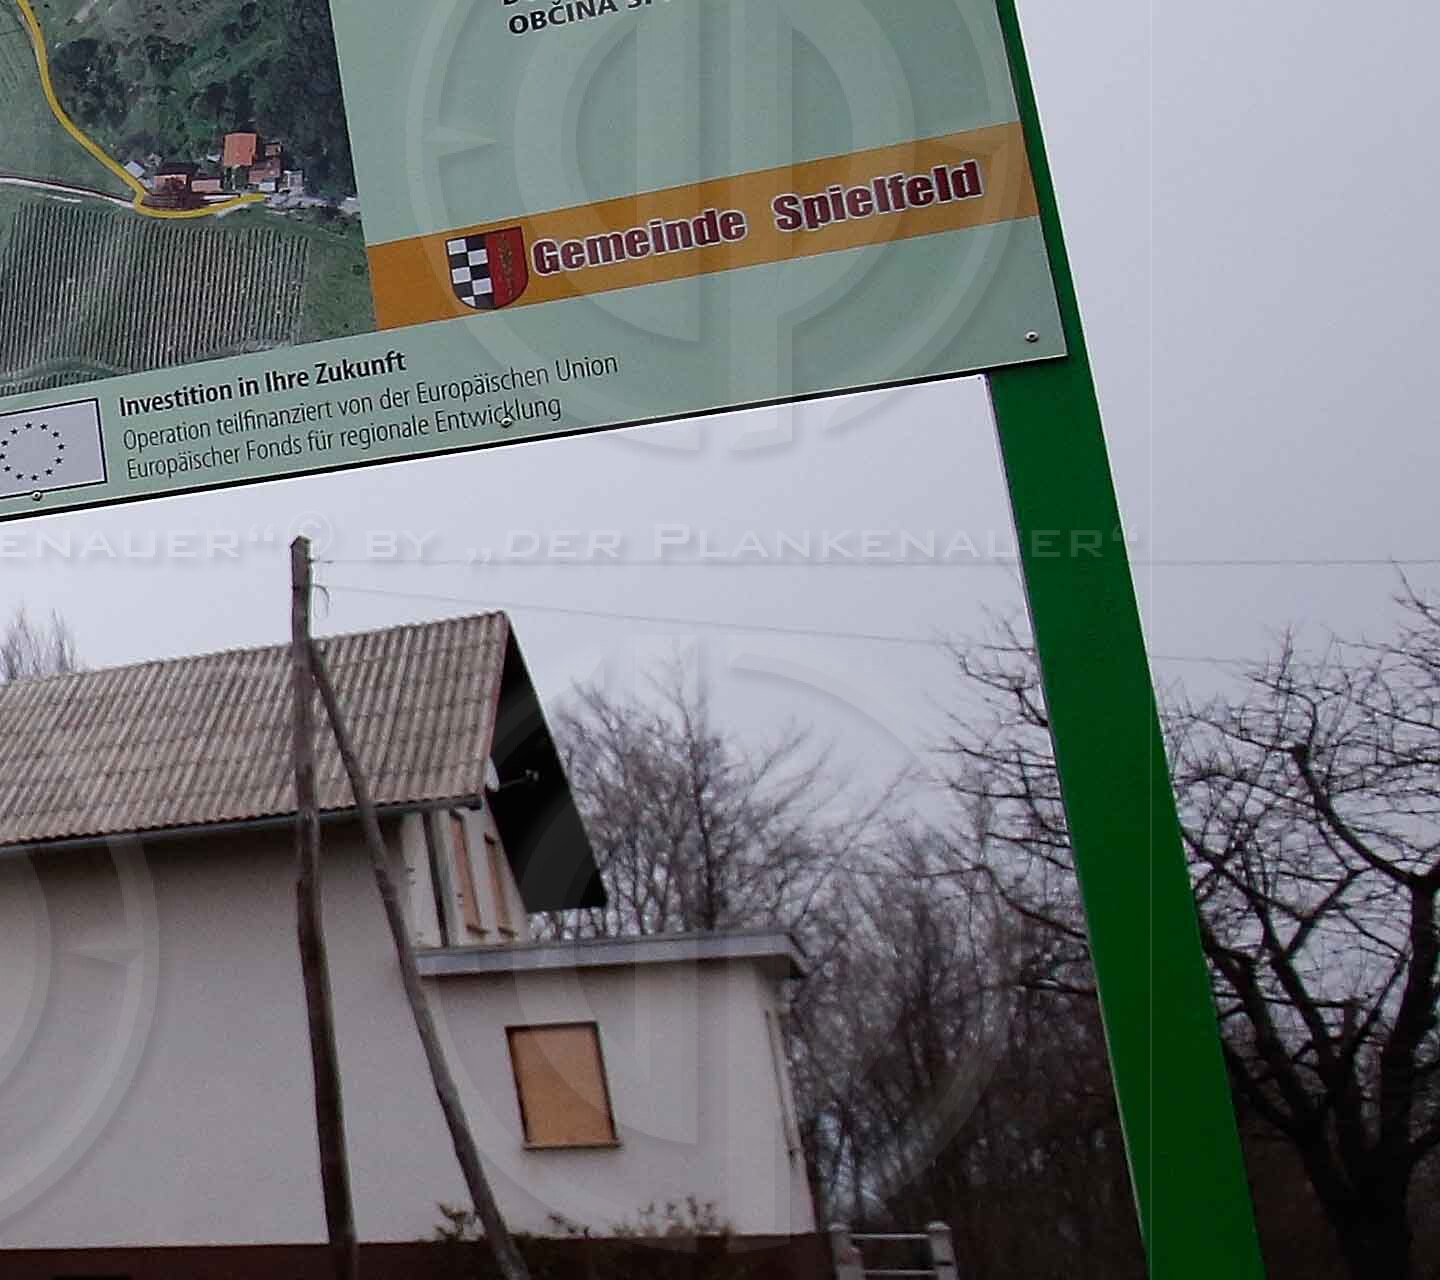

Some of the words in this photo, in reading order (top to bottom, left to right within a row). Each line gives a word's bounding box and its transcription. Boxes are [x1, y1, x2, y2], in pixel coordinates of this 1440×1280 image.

[532, 208, 748, 276] Gemeinde
[771, 160, 983, 232] Spielfeld
[120, 384, 232, 416] Investition
[238, 377, 259, 397] in
[265, 371, 309, 392] Ihre
[315, 351, 407, 384] Zukunft
[124, 421, 211, 452] Operation
[216, 400, 333, 436] teilfinanziert
[337, 397, 373, 416] von
[379, 387, 410, 409] der
[416, 366, 549, 403] Europäischen
[556, 357, 618, 381] Union
[127, 445, 240, 479] Europäischer
[246, 434, 302, 461] Fonds
[307, 430, 334, 451] für
[340, 414, 430, 450] regionale
[435, 398, 561, 432] Entwicklung
